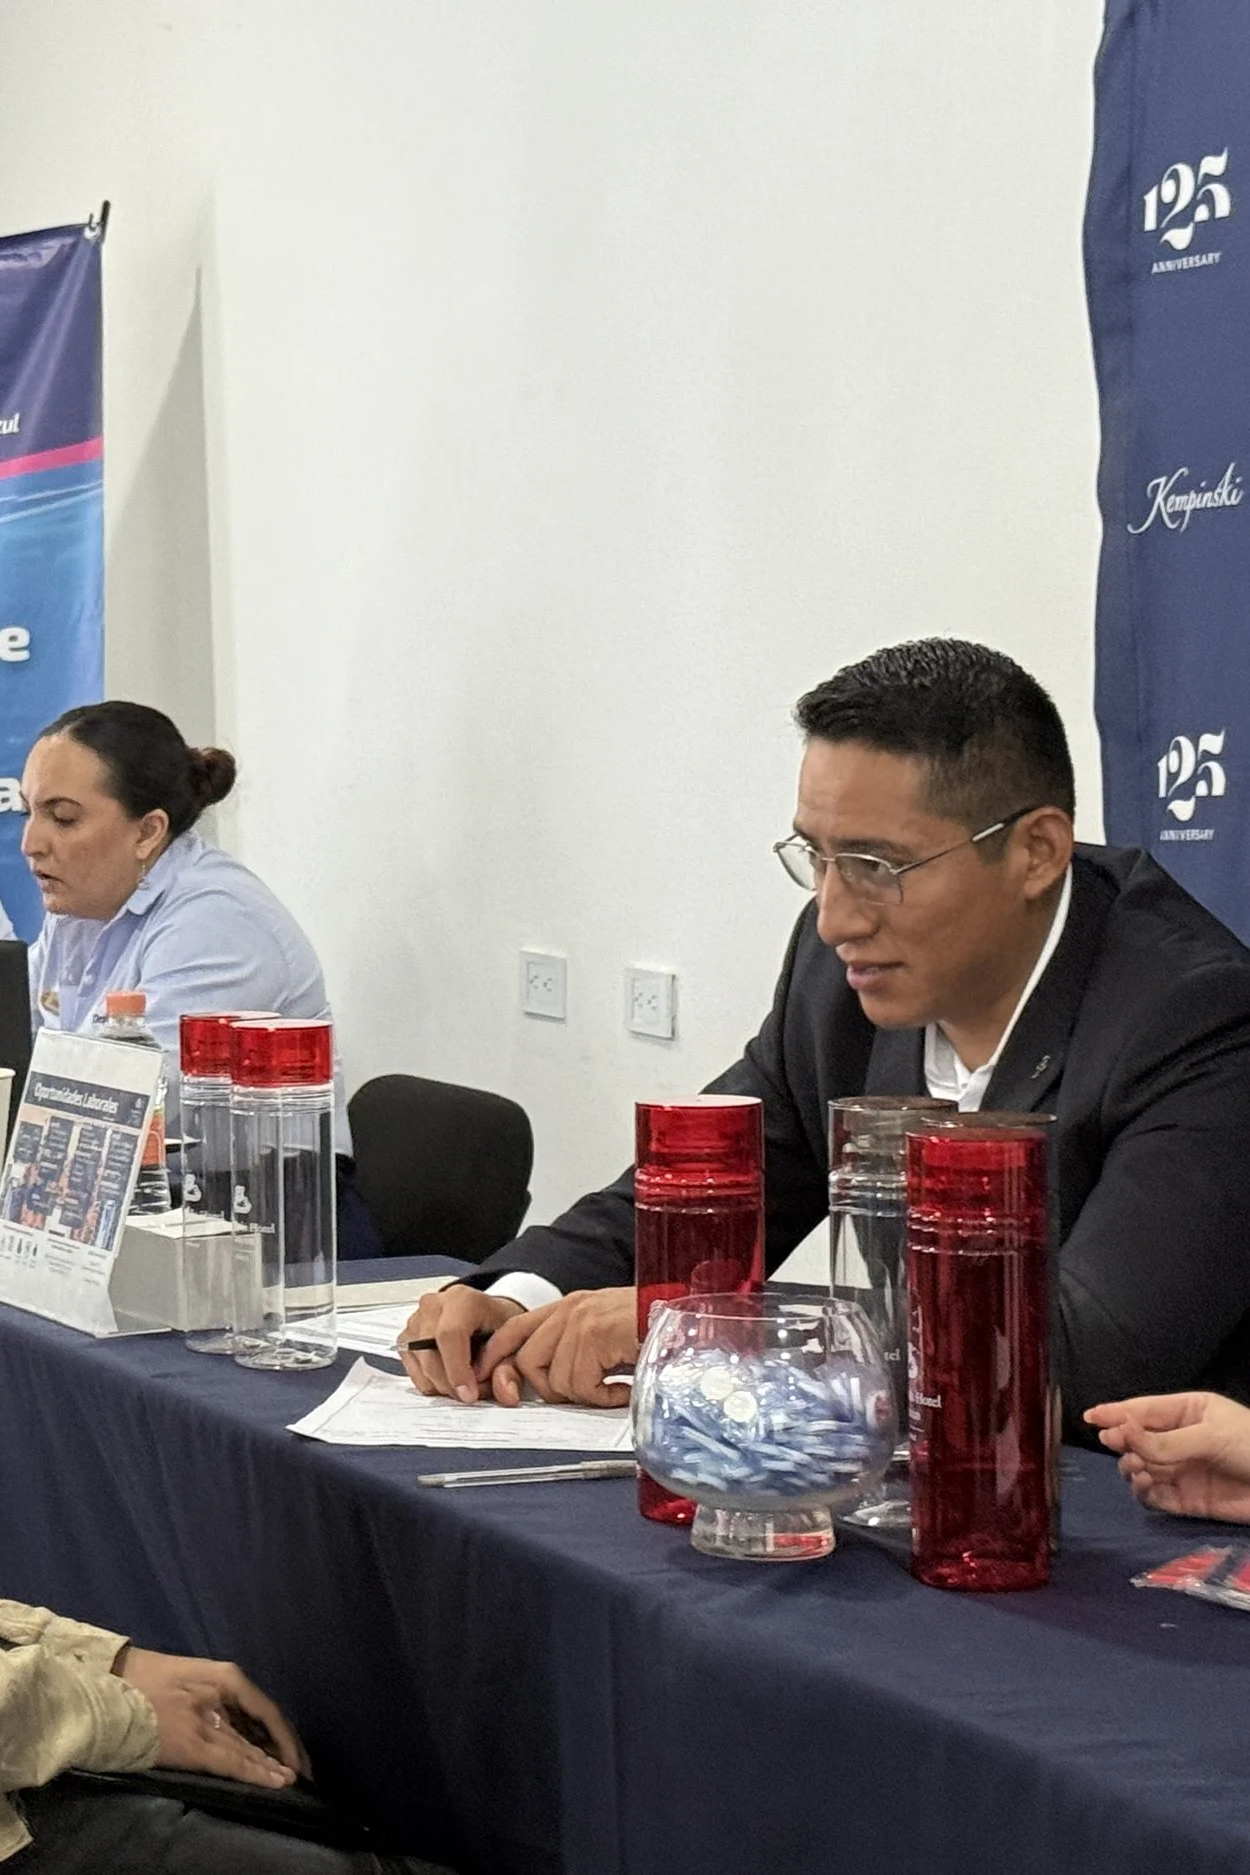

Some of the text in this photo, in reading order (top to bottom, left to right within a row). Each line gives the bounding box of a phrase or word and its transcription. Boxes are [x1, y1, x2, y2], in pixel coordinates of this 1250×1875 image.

[1143, 146, 1231, 251] 125
[1151, 252, 1222, 274] ANNIVERSARY
[1127, 462, 1244, 534] Kempinski
[1157, 728, 1226, 822] 125
